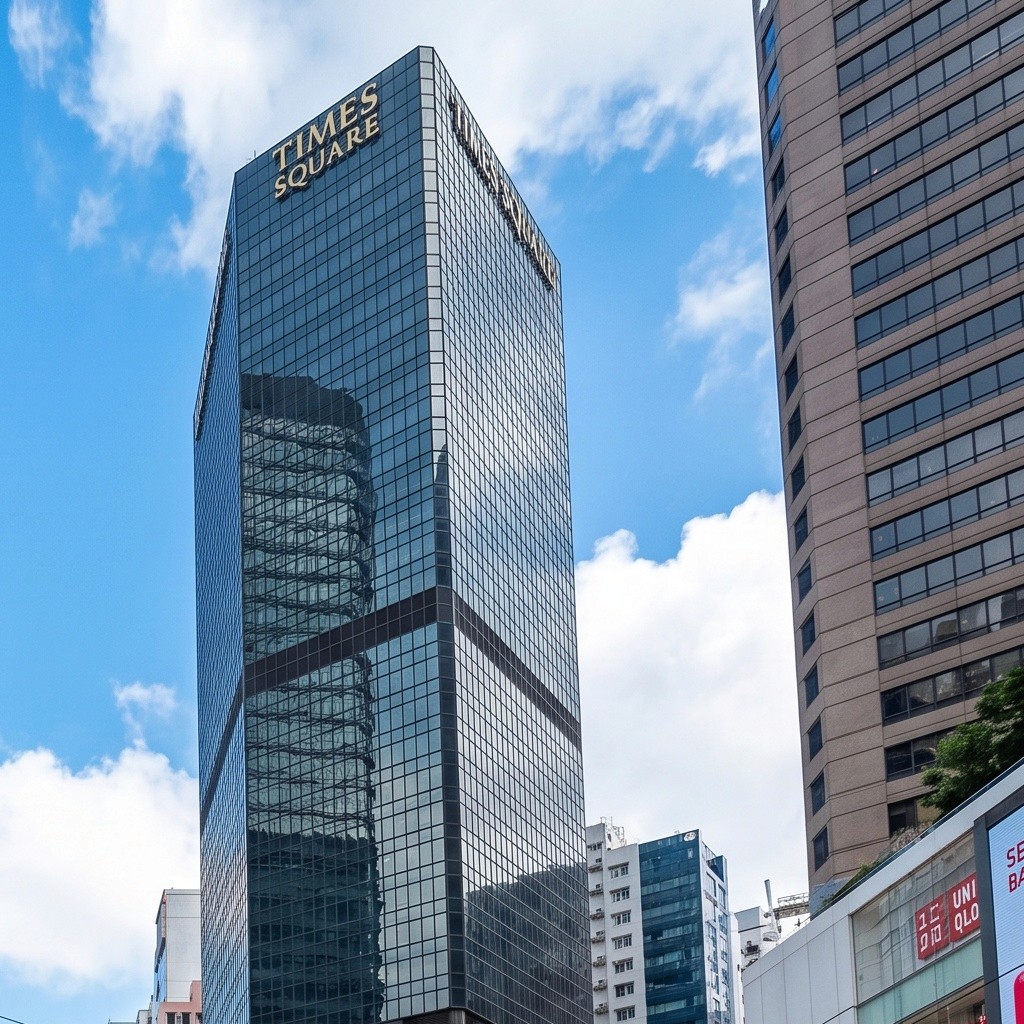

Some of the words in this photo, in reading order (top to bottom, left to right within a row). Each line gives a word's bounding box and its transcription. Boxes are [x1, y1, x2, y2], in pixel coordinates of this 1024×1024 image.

[272, 82, 379, 172] TIMES
[274, 113, 380, 199] SQUARE
[952, 878, 977, 910] UNI
[954, 902, 979, 934] QLO
